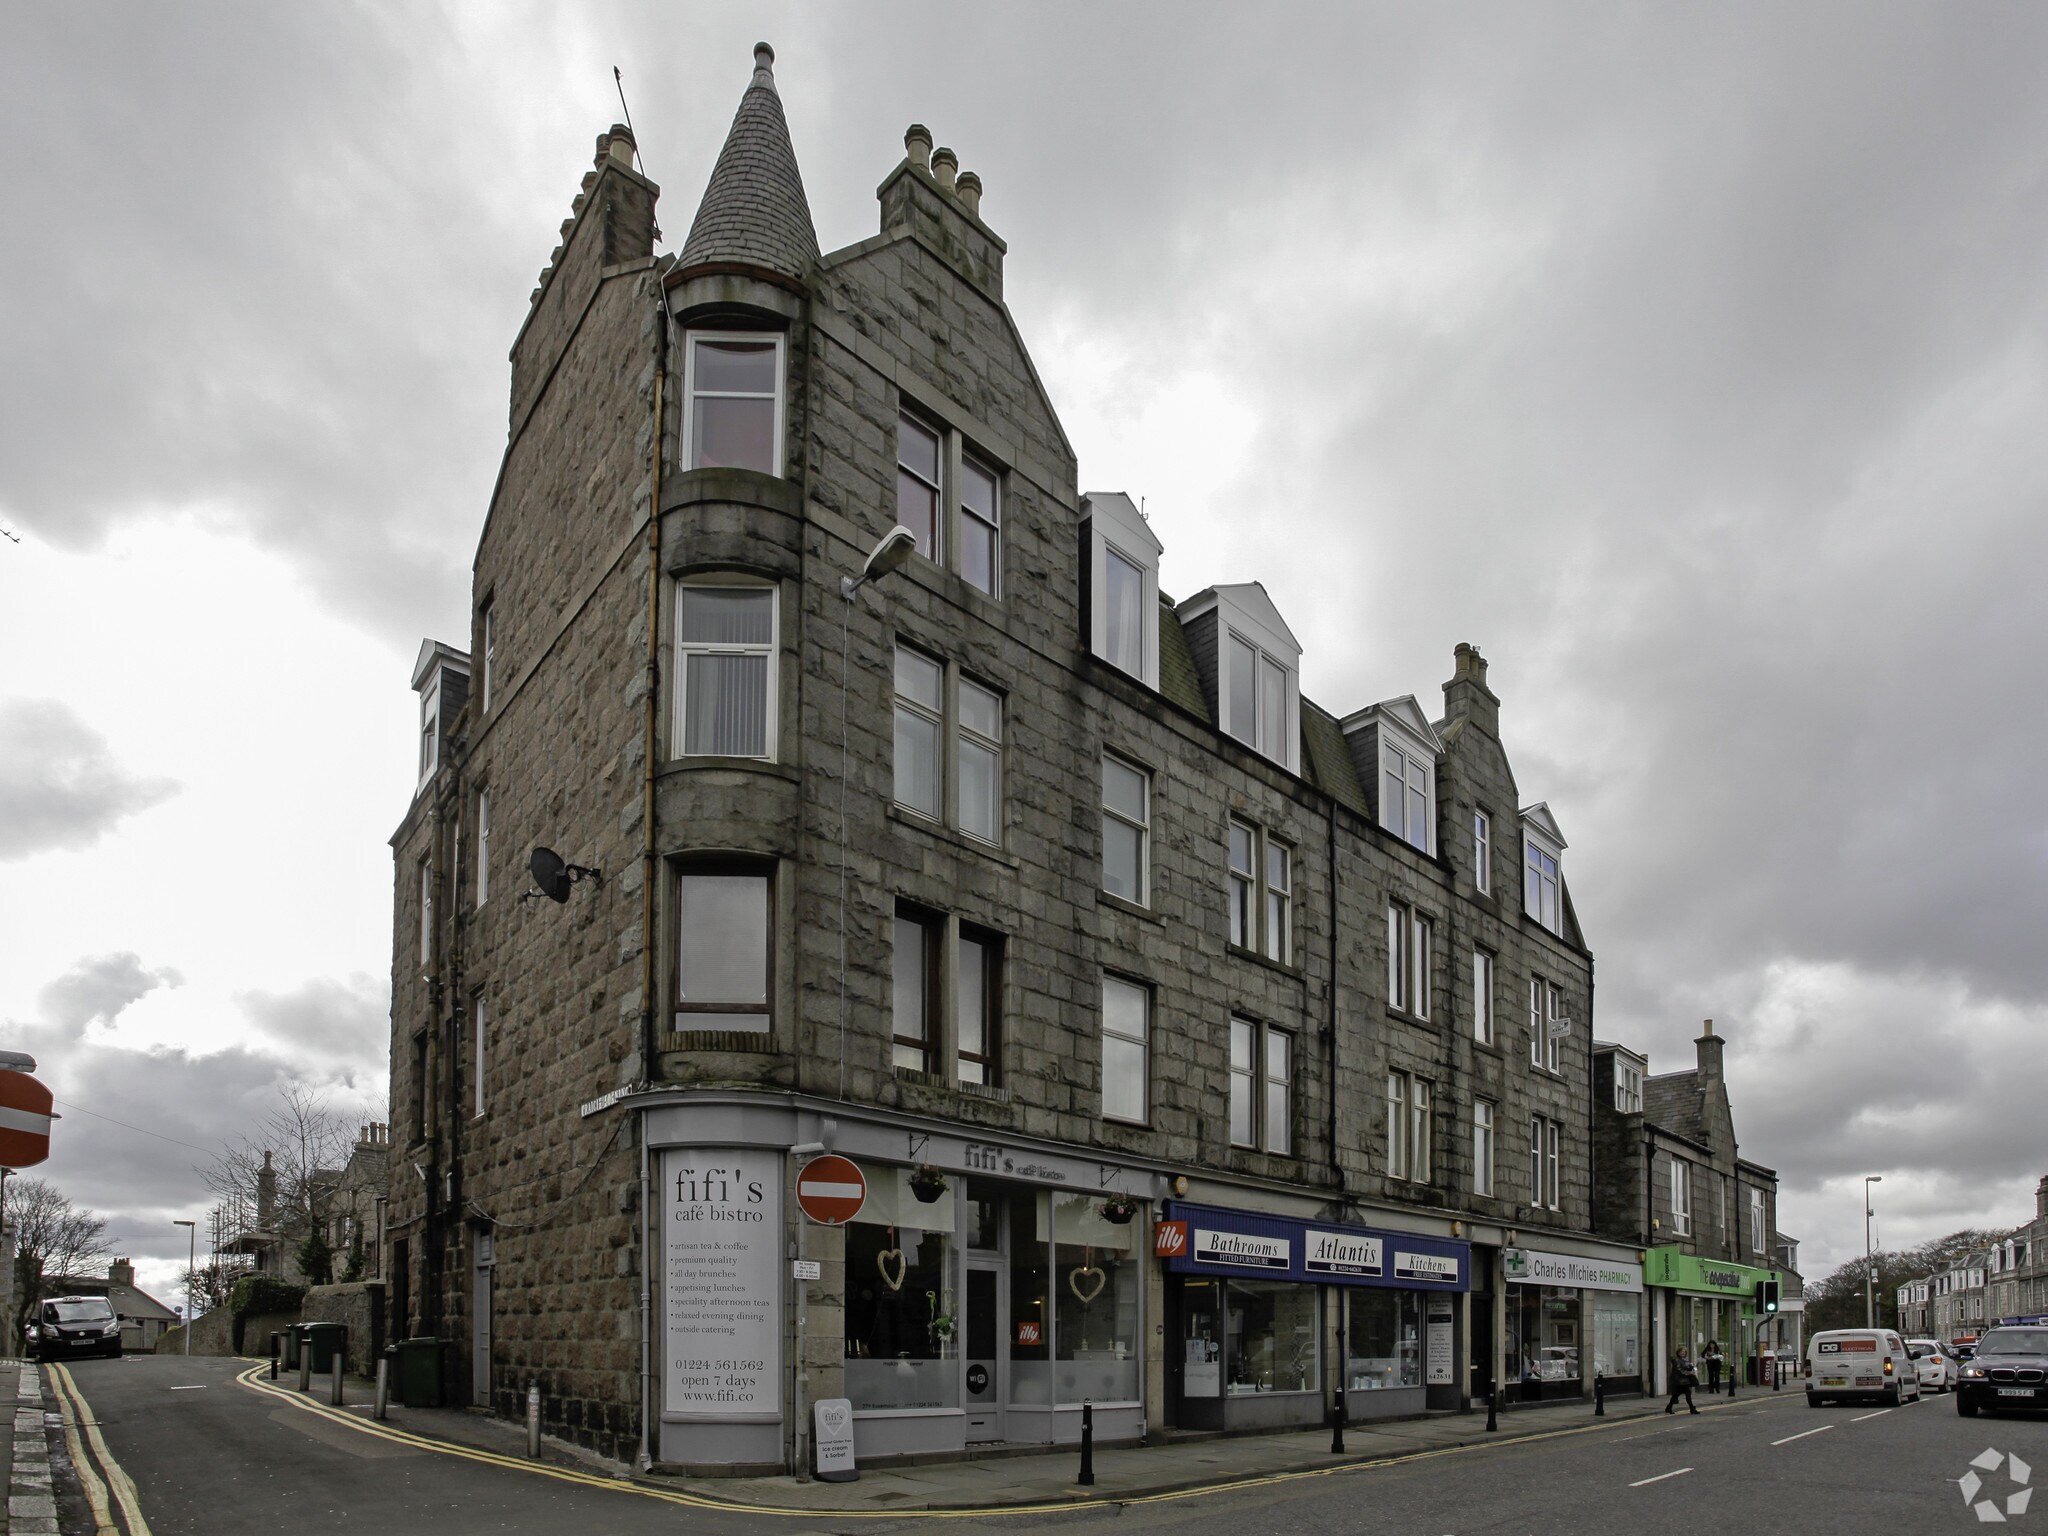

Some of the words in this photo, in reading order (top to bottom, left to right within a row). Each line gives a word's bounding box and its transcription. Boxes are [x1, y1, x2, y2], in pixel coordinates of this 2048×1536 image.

[965, 1144, 1014, 1172] fifi's
[676, 1169, 762, 1203] fifi's
[676, 1205, 704, 1221] café
[710, 1205, 762, 1222] bistro
[1157, 1226, 1184, 1253] illy
[1210, 1234, 1278, 1256] Bathrooms
[700, 1242, 712, 1250] tea
[714, 1242, 720, 1250] &
[724, 1242, 748, 1250] coffee
[1315, 1237, 1376, 1263] Atlantis
[675, 1256, 706, 1266] premium
[708, 1256, 737, 1266] quality
[1219, 1254, 1238, 1262] FITTED
[1239, 1255, 1269, 1265] FURNITURE
[1410, 1256, 1446, 1271] Kitchens
[685, 1270, 697, 1280] day
[699, 1270, 736, 1278] brunches
[1534, 1260, 1566, 1278] Charles
[1569, 1264, 1597, 1281] Michies
[1600, 1270, 1631, 1284] PHARMACY
[1699, 1265, 1708, 1284] The
[675, 1284, 712, 1293] appetising
[714, 1284, 746, 1292] lunches
[675, 1298, 708, 1307] speciality
[710, 1298, 750, 1306] afternoon
[702, 1312, 734, 1322] evening
[736, 1312, 764, 1322] dining
[702, 1326, 735, 1336] catering
[1020, 1325, 1039, 1343] illy
[1822, 1344, 1838, 1352] DG
[676, 1360, 710, 1369] 01224
[715, 1360, 764, 1370] 561562
[682, 1376, 709, 1388] open
[714, 1376, 720, 1386] 7
[726, 1374, 756, 1389] days
[684, 1390, 754, 1401] www.fifi.co
[826, 1413, 843, 1421] fifi's
